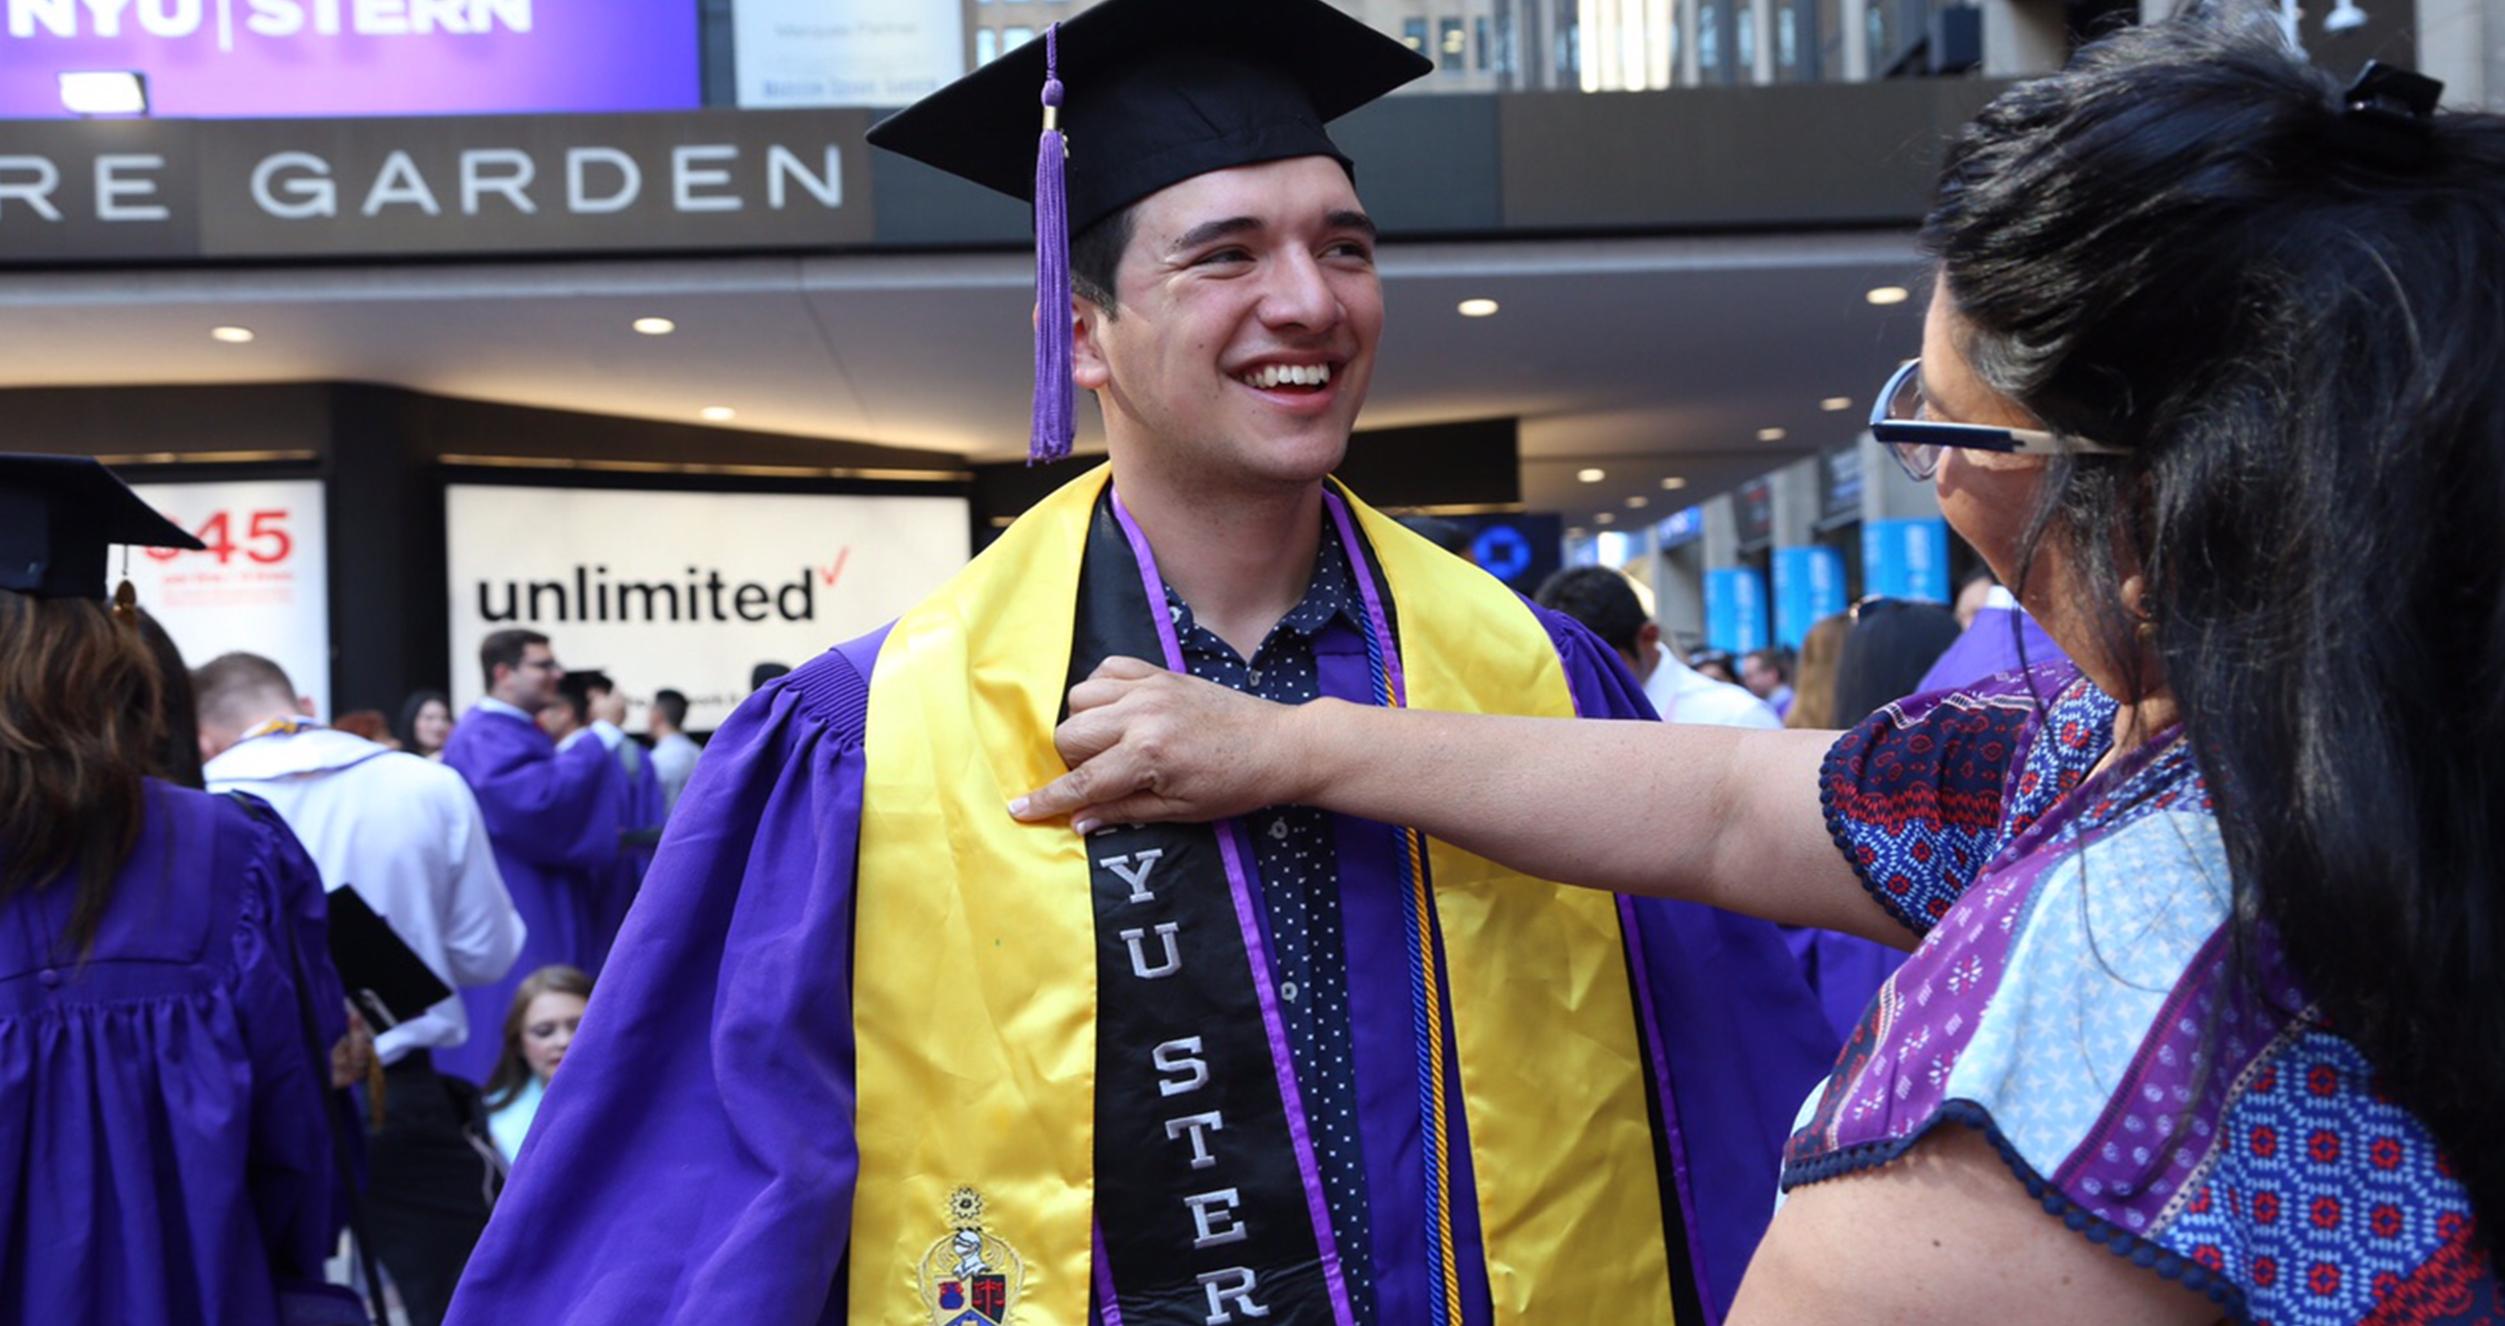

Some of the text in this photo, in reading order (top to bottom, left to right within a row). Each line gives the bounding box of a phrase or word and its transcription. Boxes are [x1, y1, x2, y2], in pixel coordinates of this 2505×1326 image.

[6, 0, 533, 38] NYU STERN
[250, 145, 843, 219] GARDEN
[478, 565, 816, 623] unlimited
[1095, 823, 1183, 979] YU
